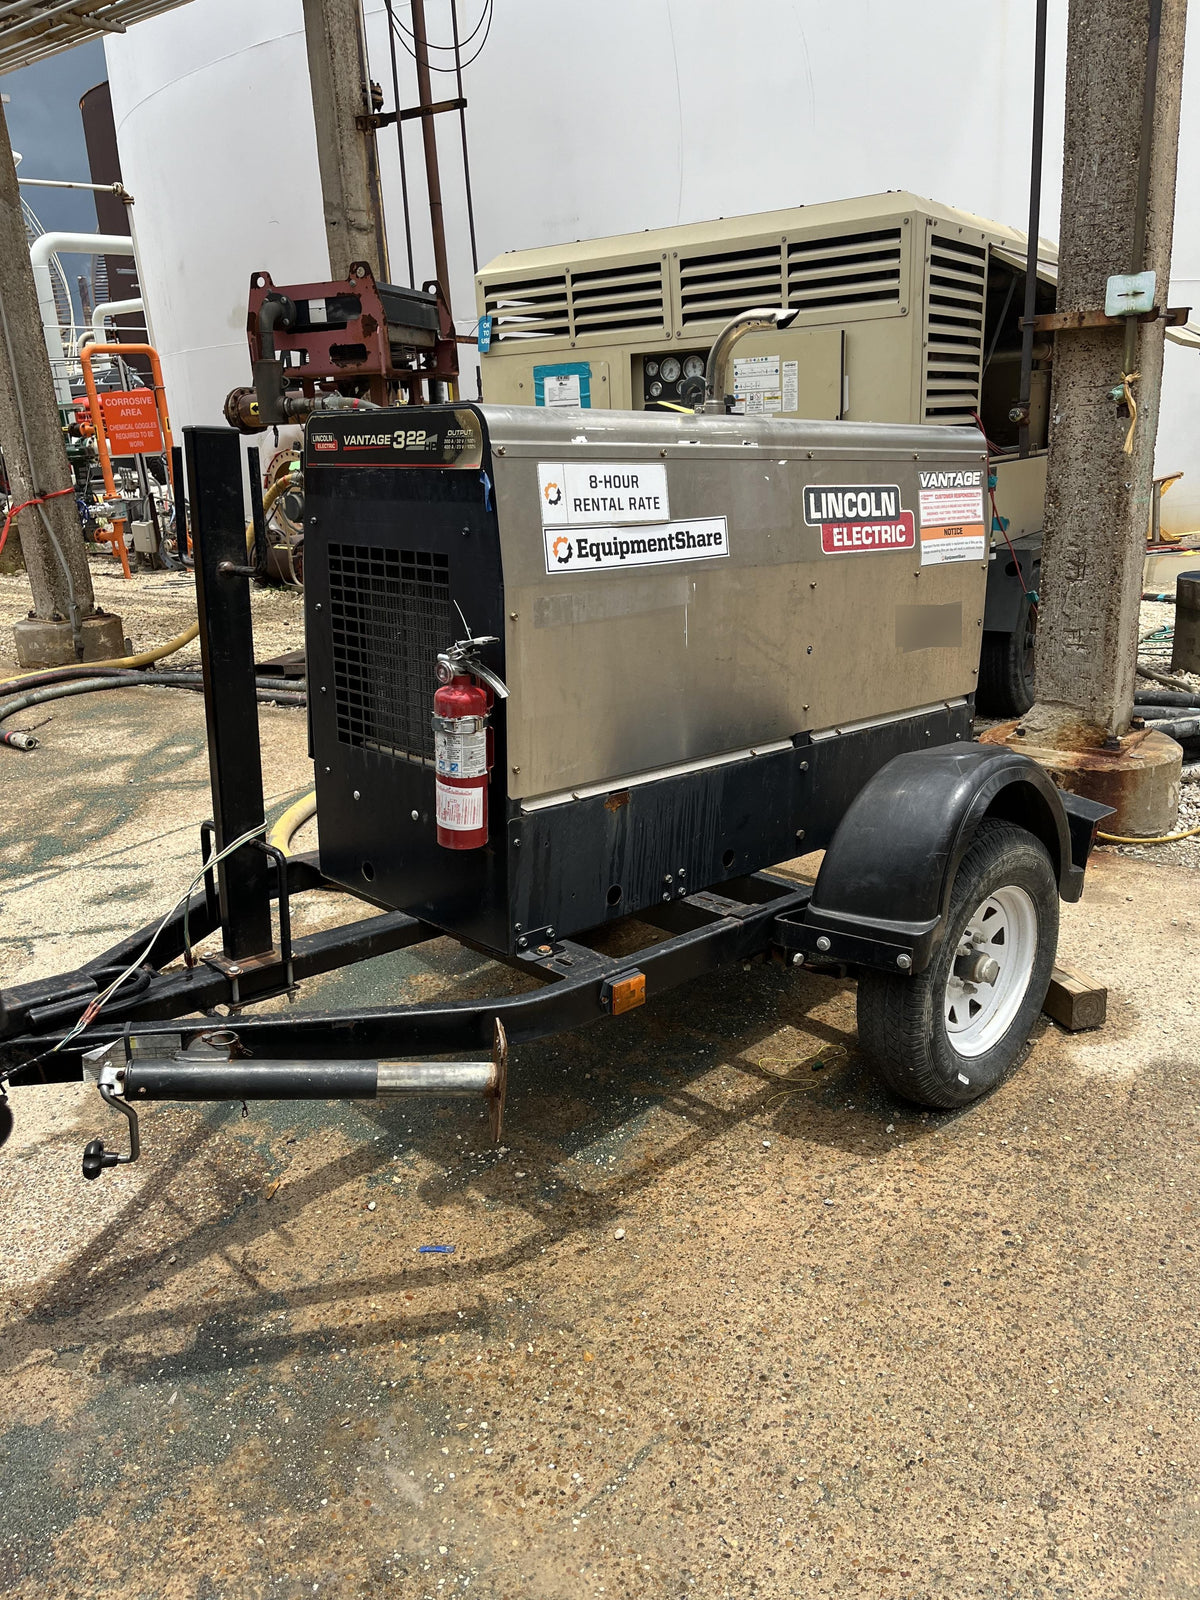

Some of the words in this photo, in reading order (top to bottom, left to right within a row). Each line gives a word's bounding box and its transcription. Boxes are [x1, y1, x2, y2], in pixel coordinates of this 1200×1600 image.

[105, 396, 153, 407] CORROSIVE
[120, 408, 143, 417] AREA
[109, 423, 135, 432] CHEMICAL
[134, 421, 157, 430] GOGGLES
[115, 432, 140, 440] REQUIRED
[312, 434, 333, 442] LINCOLN
[343, 434, 392, 446] VANTAGE
[392, 430, 426, 449] 322
[128, 440, 145, 448] WORN
[588, 474, 640, 489] 8-HOUR
[919, 471, 982, 489] VANTAGE
[573, 497, 625, 512] RENTAL
[628, 496, 661, 511] RATE
[809, 491, 896, 519] LINCOLN
[832, 524, 906, 547] ELECTRIC
[943, 527, 964, 536] NOTICE
[575, 530, 723, 562] EquipmentShare
